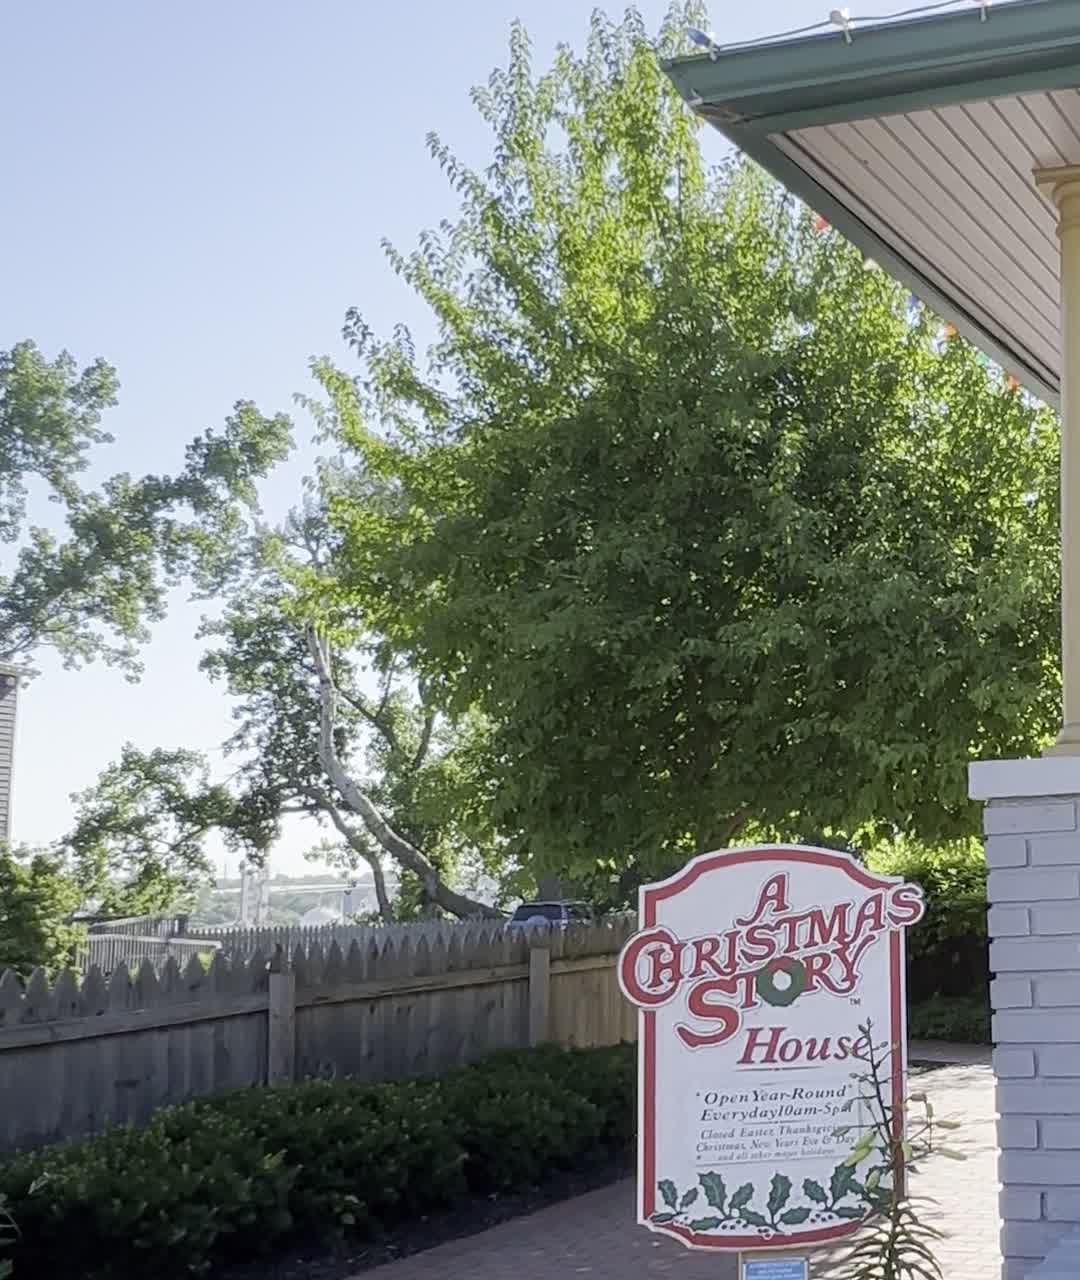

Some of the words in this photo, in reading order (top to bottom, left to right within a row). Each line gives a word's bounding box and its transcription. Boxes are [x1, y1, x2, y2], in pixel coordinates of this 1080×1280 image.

[736, 873, 789, 927] A
[621, 885, 923, 1005] CHRISTMAS
[736, 1026, 869, 1065] House
